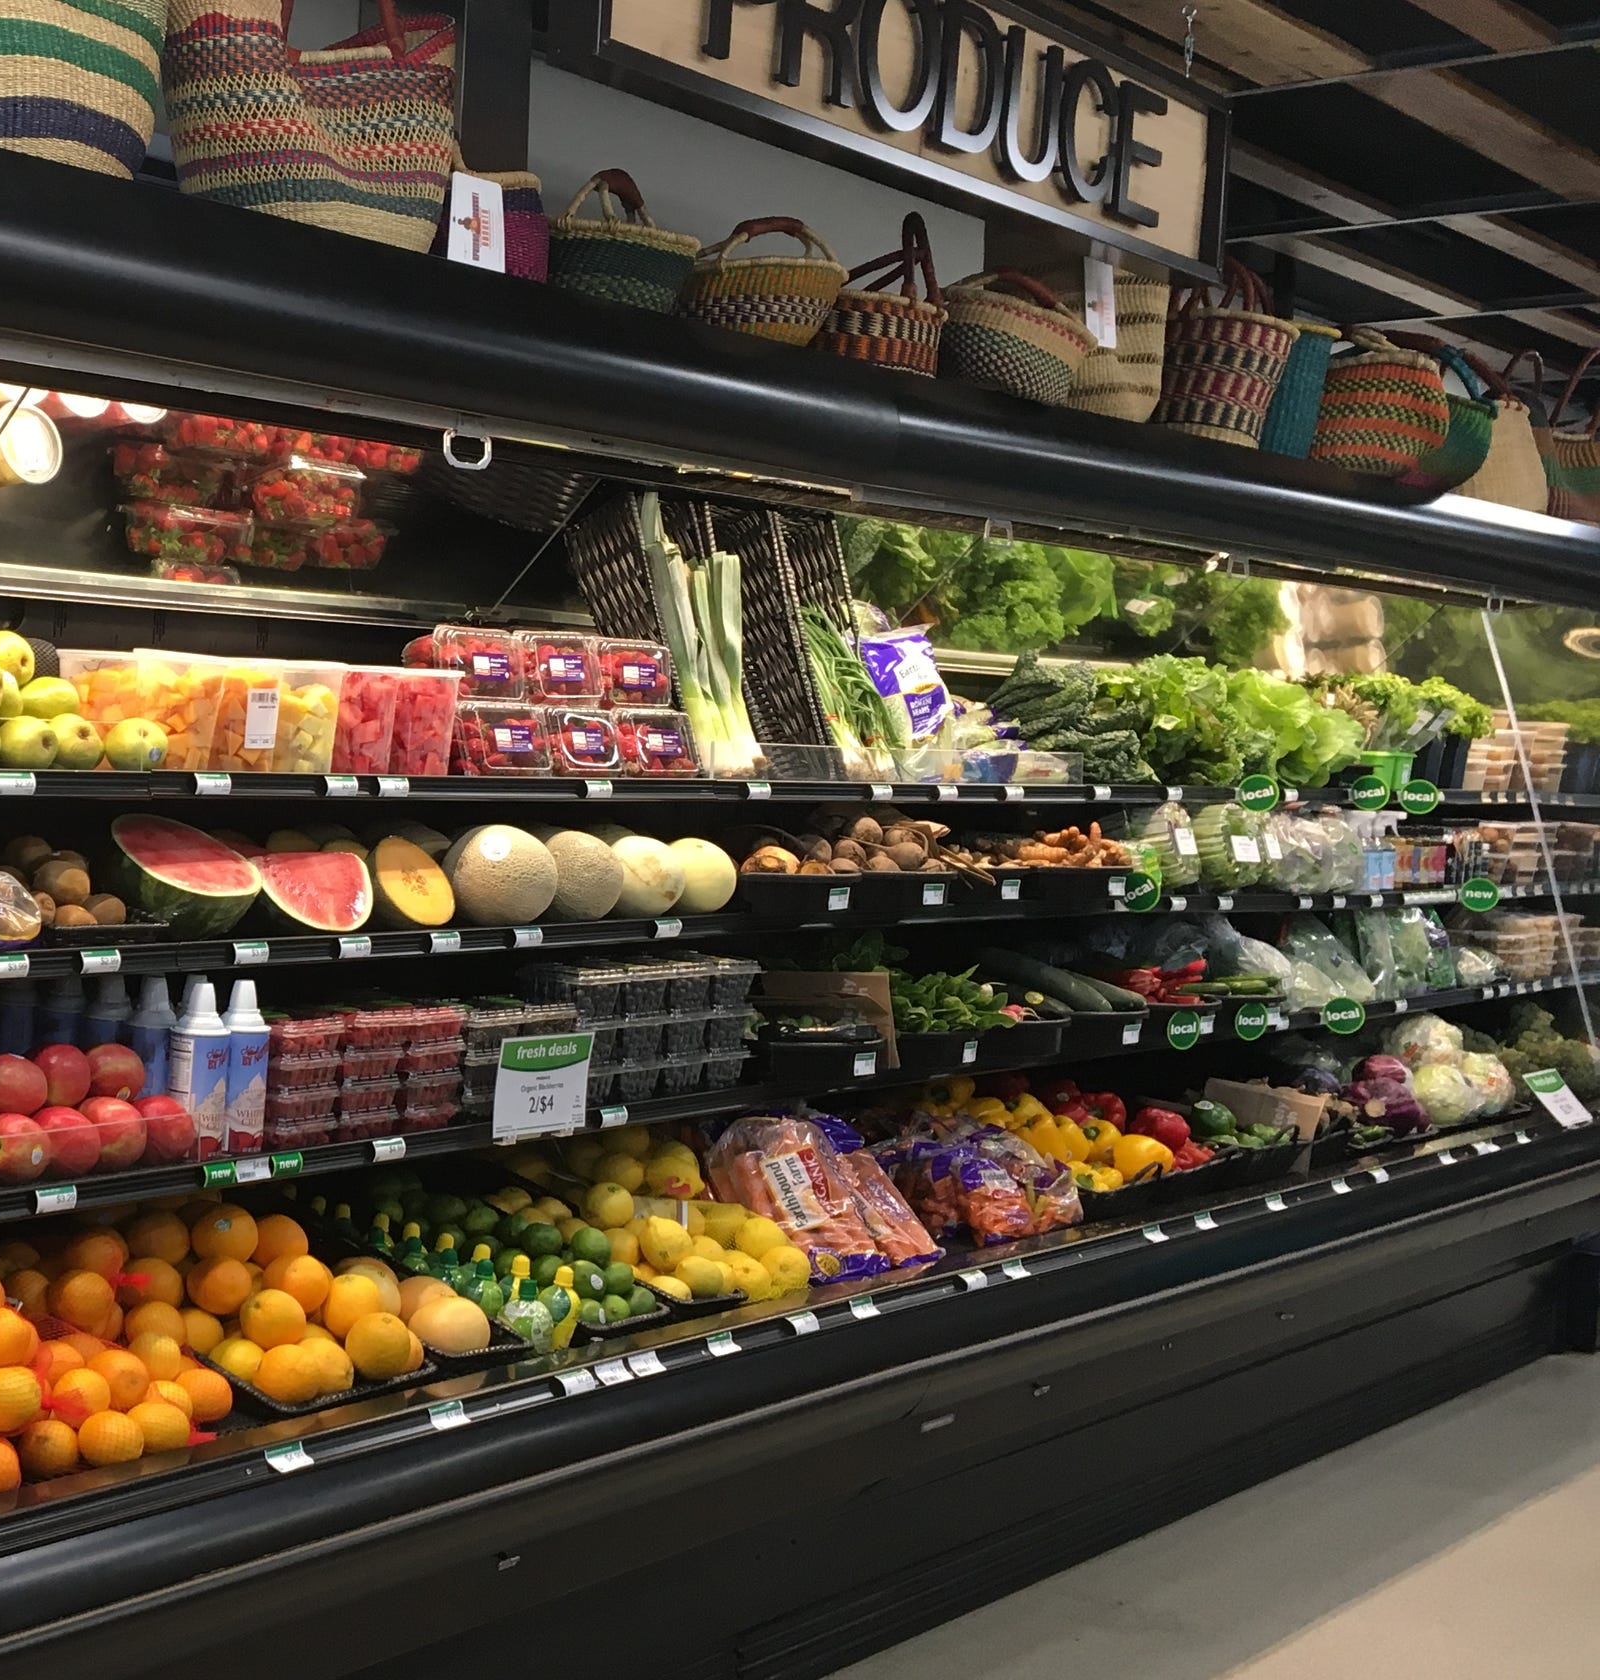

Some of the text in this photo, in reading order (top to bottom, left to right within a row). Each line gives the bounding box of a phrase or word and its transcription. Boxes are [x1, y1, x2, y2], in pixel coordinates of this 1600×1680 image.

[1241, 785, 1275, 801] local
[1354, 787, 1386, 799] local
[1403, 790, 1436, 802] local
[1465, 888, 1494, 899] new
[7, 963, 27, 972] $3.99
[100, 957, 119, 966] $2.99
[1238, 1014, 1264, 1026] local
[1327, 1008, 1360, 1022] local
[1170, 1021, 1197, 1036] local
[517, 1041, 578, 1059] fresh deals
[528, 1094, 554, 1114] 2/$4
[279, 1158, 299, 1169] new
[211, 1168, 231, 1179] new
[785, 1157, 806, 1186] Farm
[803, 1152, 839, 1216] ORGANIC
[56, 1194, 75, 1204] $3.29
[765, 1161, 809, 1228] Earthbound
